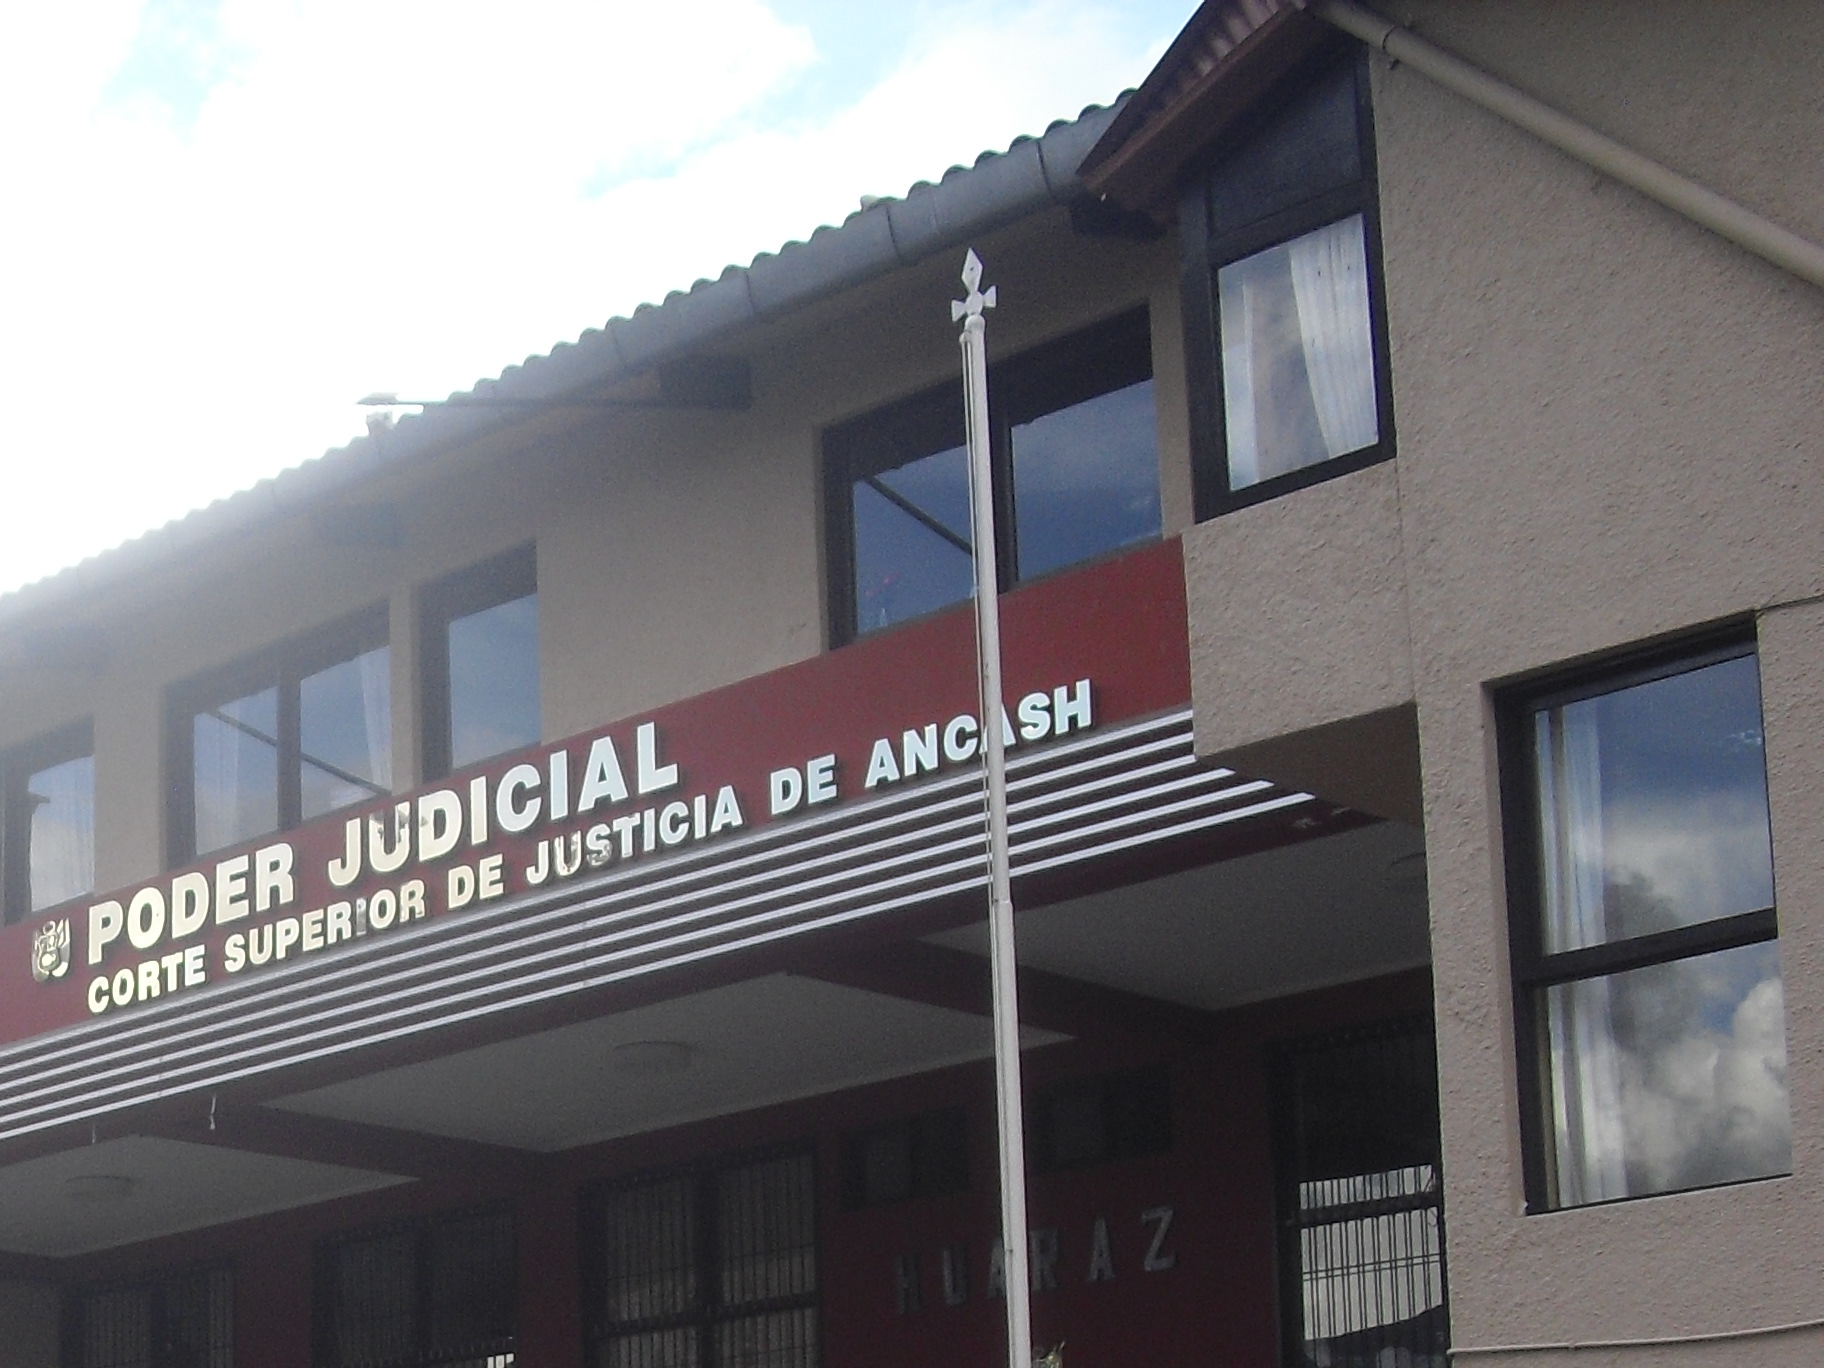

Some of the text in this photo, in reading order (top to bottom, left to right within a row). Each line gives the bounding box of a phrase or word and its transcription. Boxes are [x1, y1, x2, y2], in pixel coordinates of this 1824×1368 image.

[87, 721, 678, 966] PODER JUDICIAL
[87, 944, 206, 1014] CORTE
[224, 878, 425, 973] SUPERIOR
[447, 853, 504, 909] DE
[526, 784, 744, 885] JUSTICIA
[769, 753, 838, 815] DE
